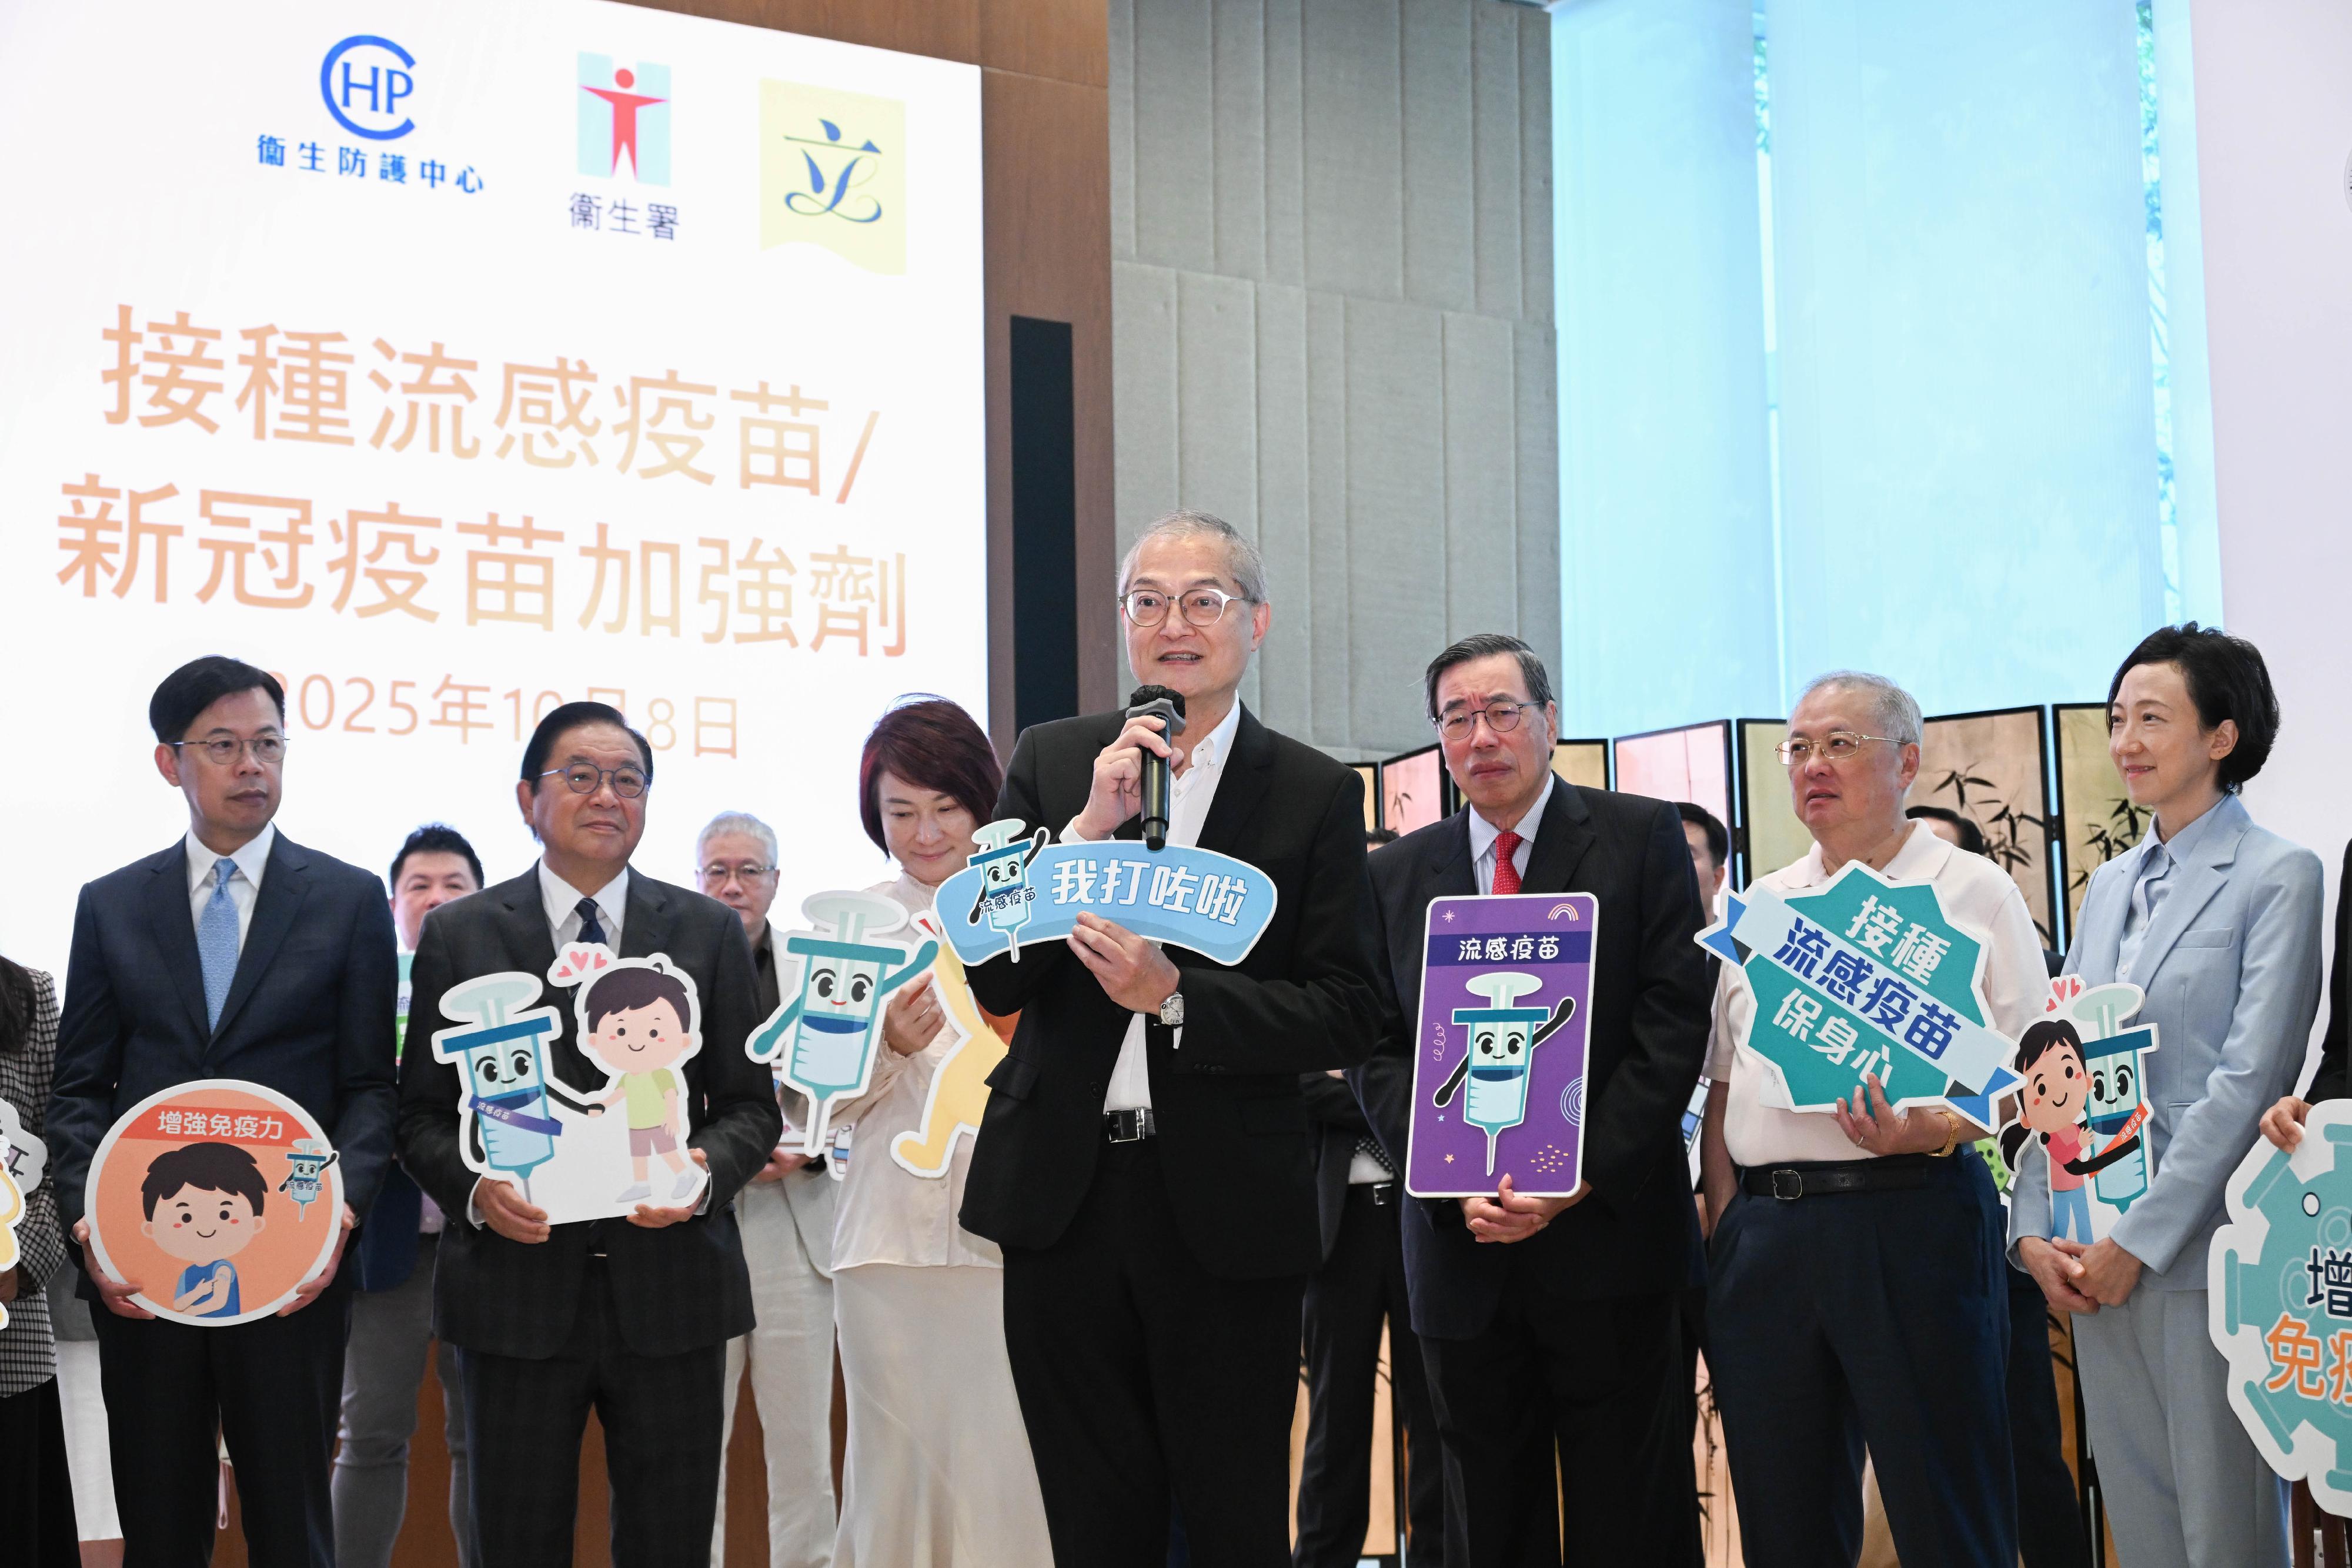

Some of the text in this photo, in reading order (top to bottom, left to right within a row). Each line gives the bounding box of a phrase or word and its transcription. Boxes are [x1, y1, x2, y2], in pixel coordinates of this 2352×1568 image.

[100, 303, 880, 504] 接種流感疫苗/
[56, 472, 907, 658] 新冠疫苗加強劑
[979, 887, 1035, 915] 流感疫苗
[1051, 859, 1248, 926] 我打咗啦
[1458, 935, 1559, 961] 流感疫苗
[1845, 895, 1952, 986] 接種
[1773, 917, 1962, 1060] 流感疫苗
[1772, 988, 1893, 1089] 保身心
[157, 1111, 283, 1139] 增強免疫力
[476, 1101, 510, 1120] 流感疫苗
[2120, 1112, 2141, 1142] 流感疫苗
